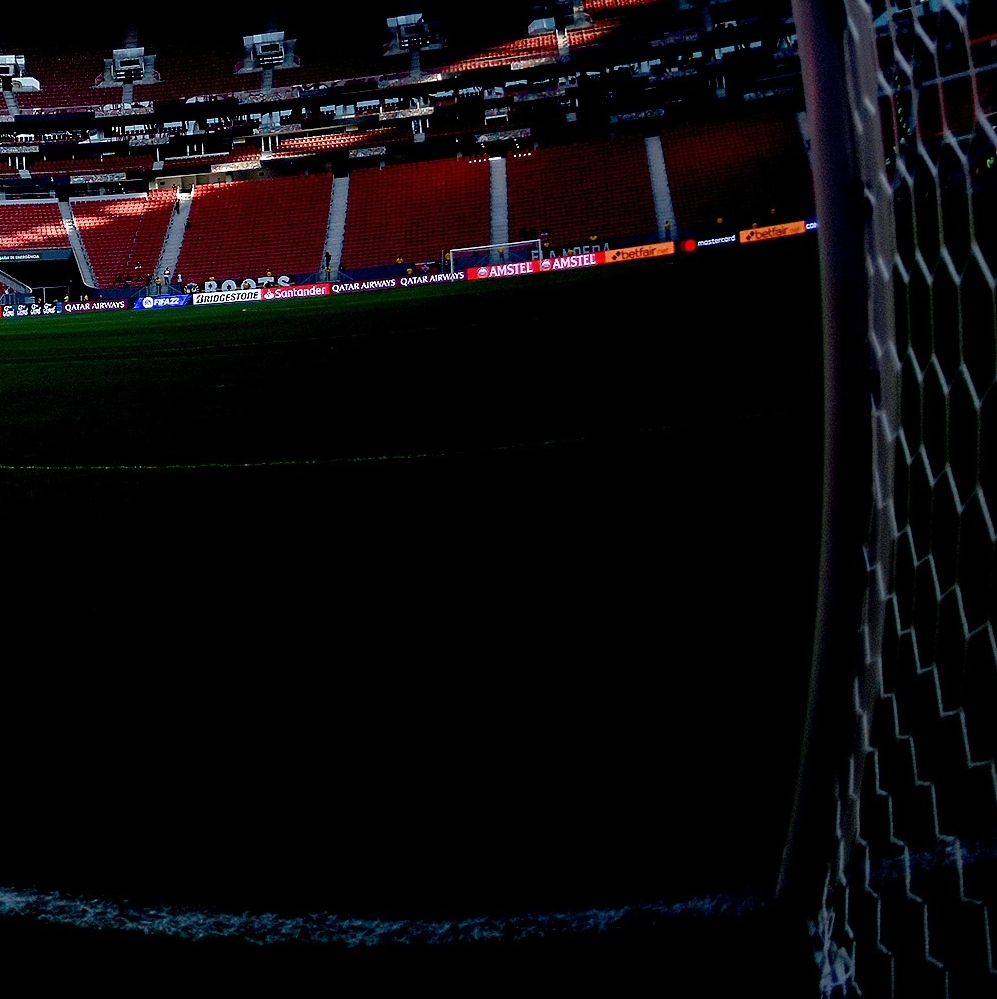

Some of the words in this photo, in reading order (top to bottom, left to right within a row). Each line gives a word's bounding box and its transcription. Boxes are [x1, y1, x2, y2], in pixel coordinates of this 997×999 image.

[697, 235, 736, 247] mastercard
[553, 253, 597, 270] AMSTEL
[488, 261, 533, 278] AMSTEL
[331, 283, 360, 294] QATAR
[361, 278, 396, 290] AIRWAYS
[400, 275, 427, 287] QATAR
[428, 271, 465, 283] AIRWAYS
[195, 291, 259, 305] BRIDGESTONE
[276, 285, 326, 299] Santander
[64, 302, 90, 313] QATAR
[91, 300, 125, 311] AIRWAYS
